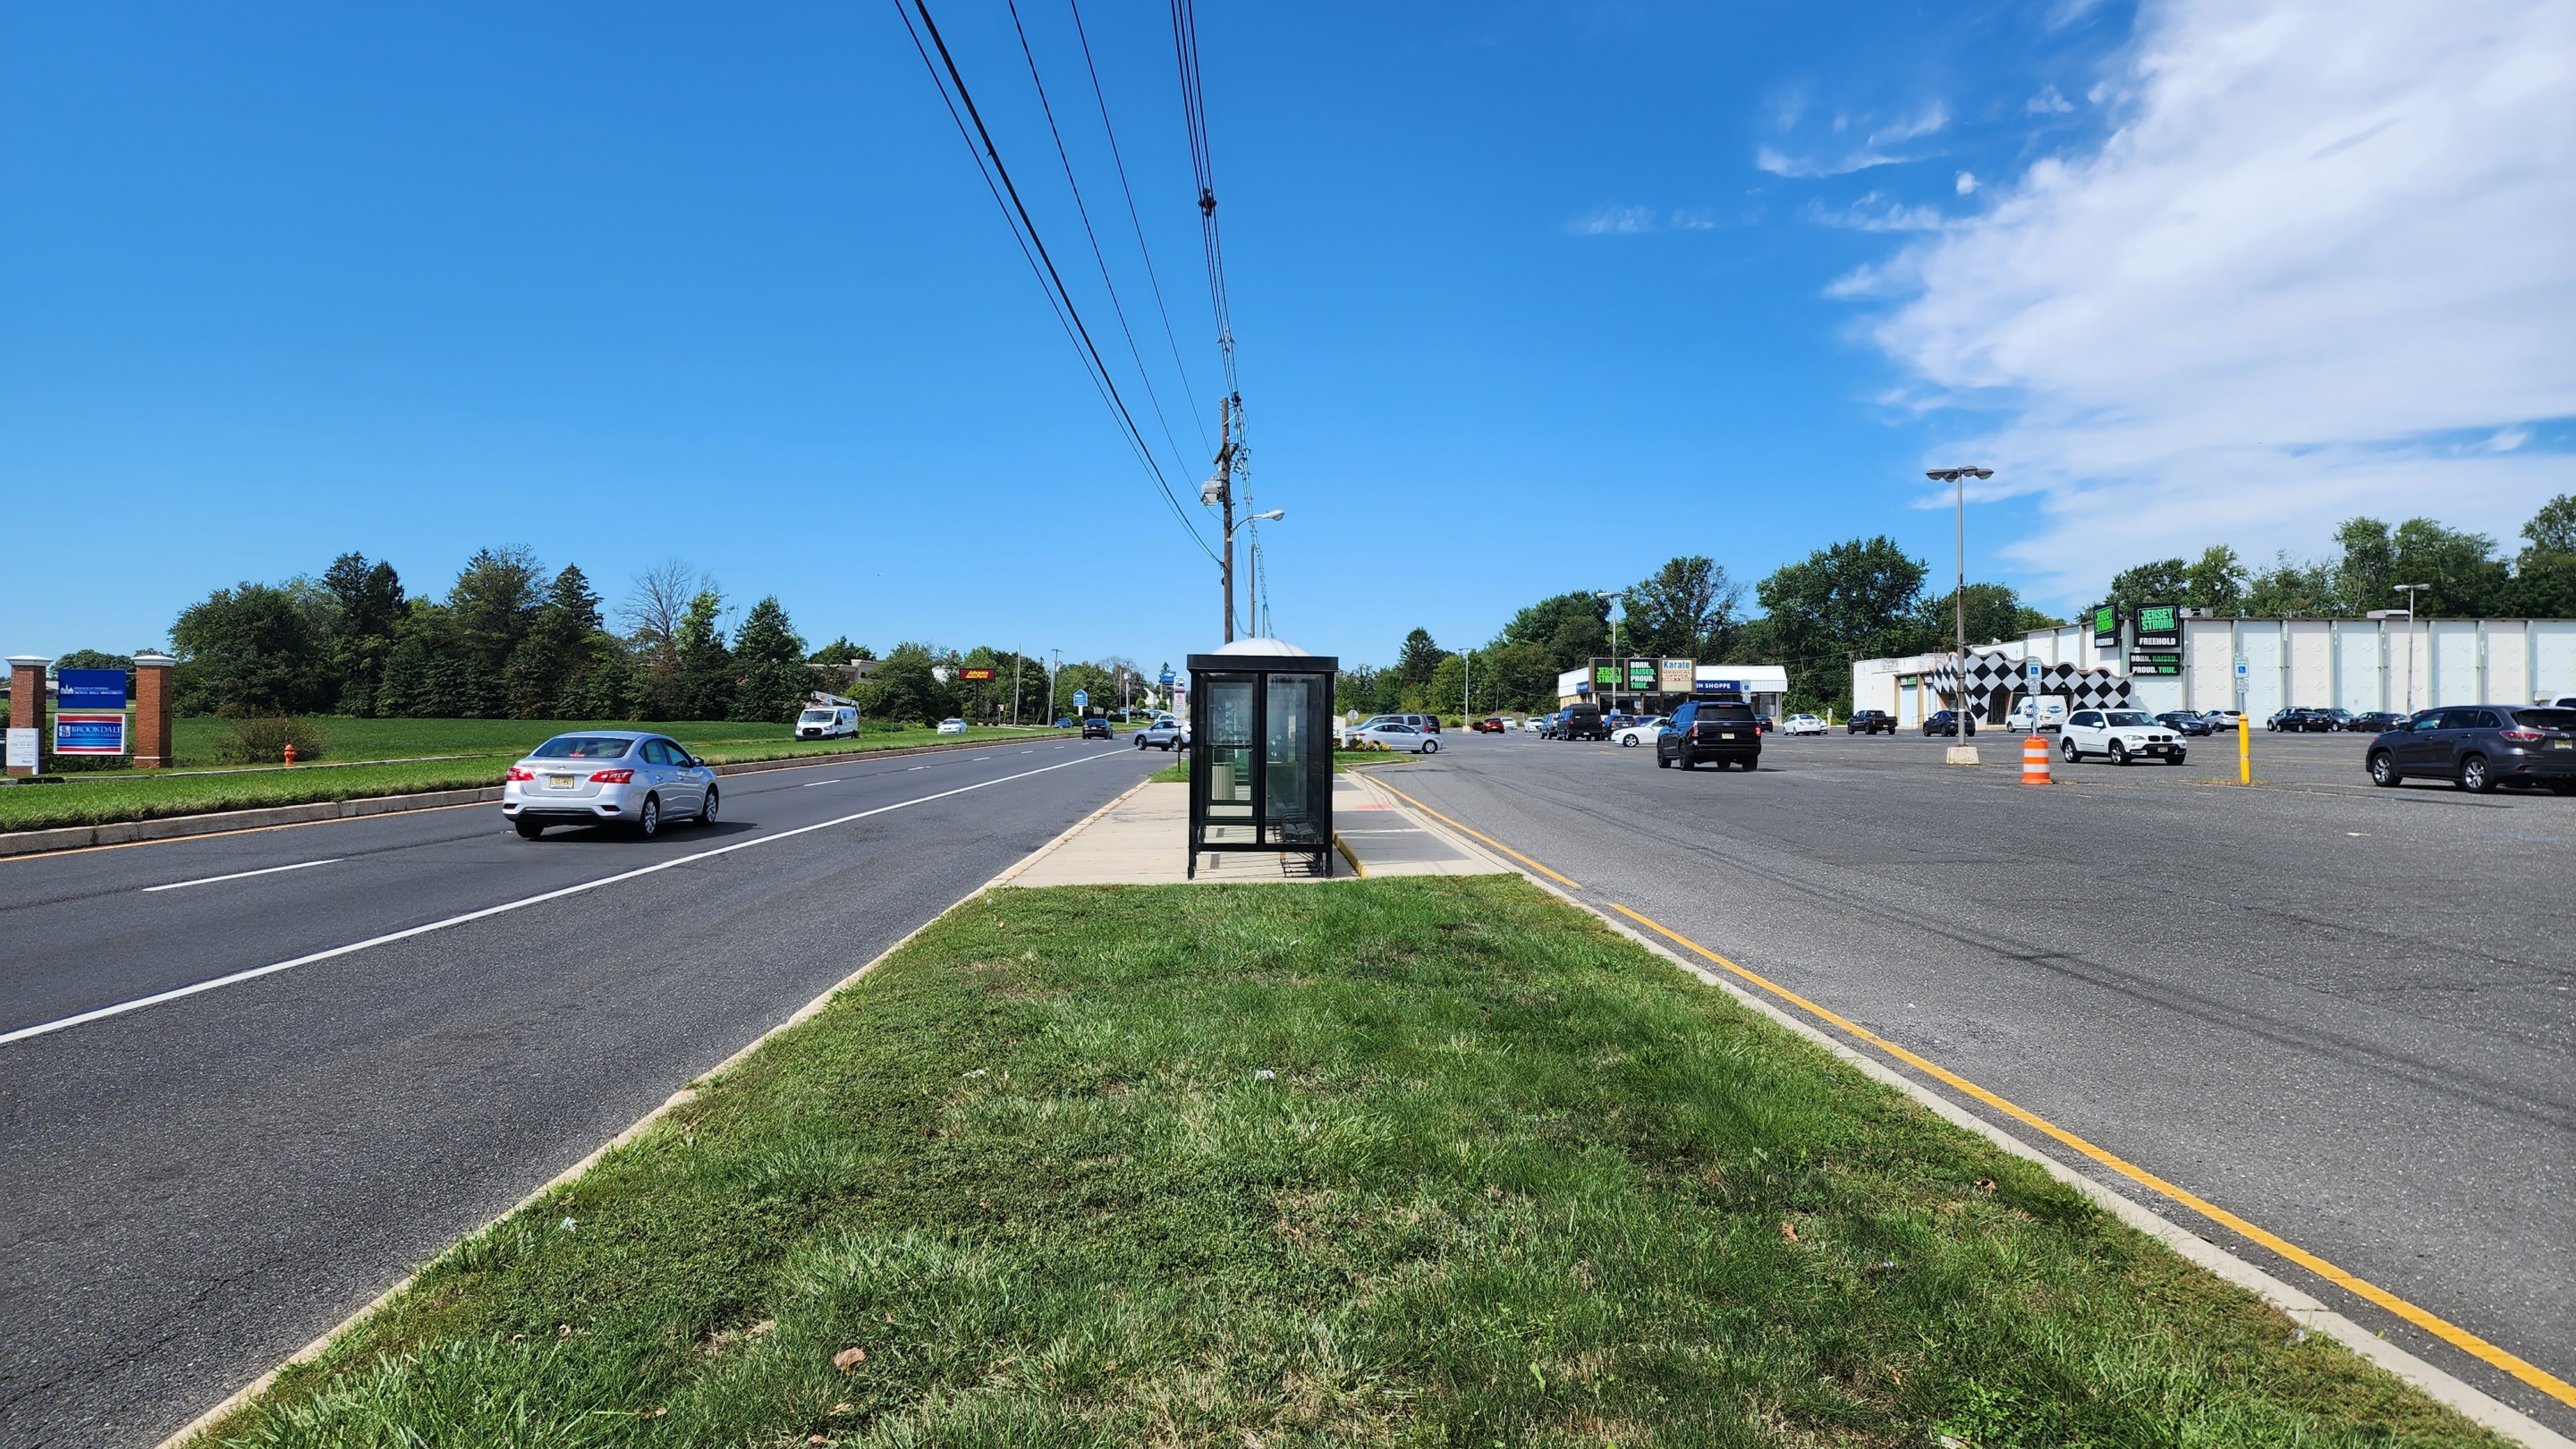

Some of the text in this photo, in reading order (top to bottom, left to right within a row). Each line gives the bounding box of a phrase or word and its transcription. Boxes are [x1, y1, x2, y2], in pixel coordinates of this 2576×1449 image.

[2141, 607, 2174, 621] JERSEY
[2141, 618, 2174, 631] STRONG
[2139, 637, 2176, 645] FREEHOLD
[1664, 661, 1690, 669] Karate
